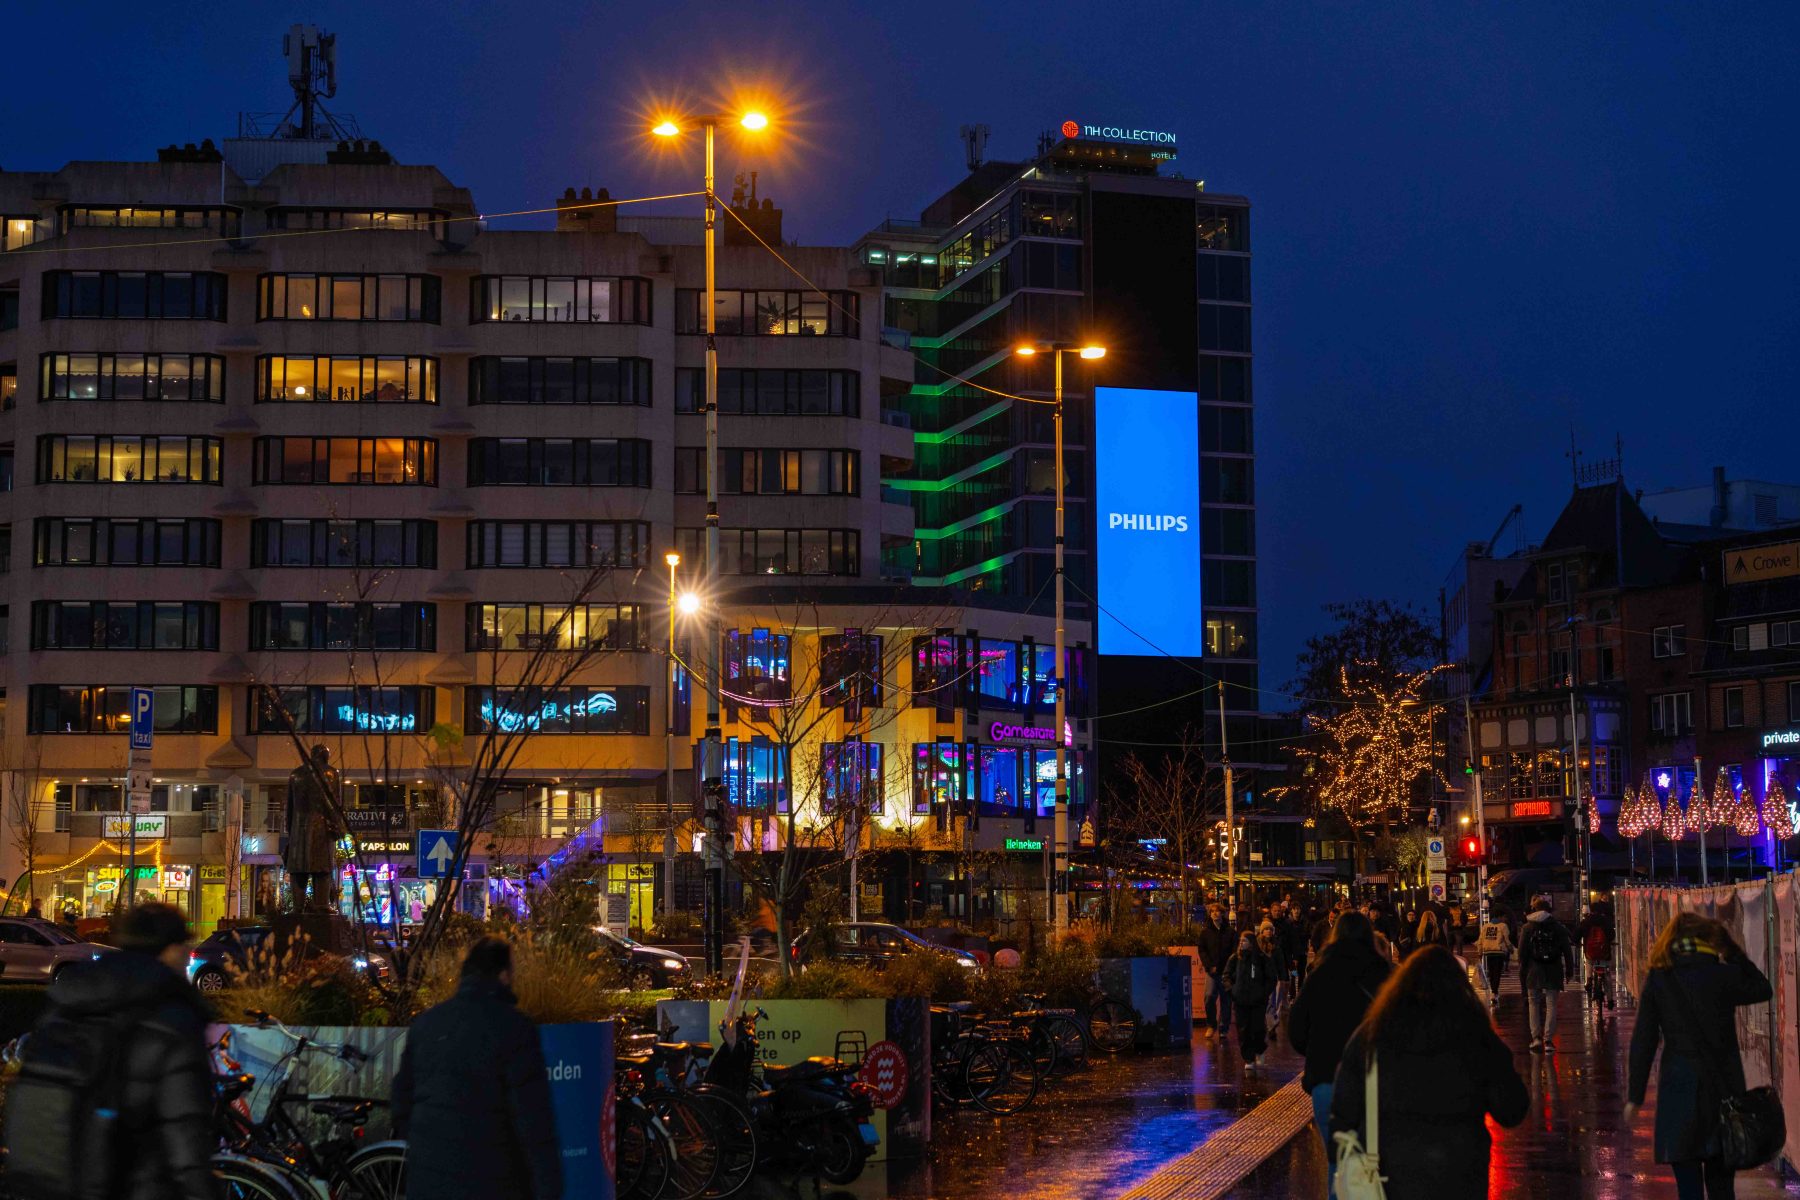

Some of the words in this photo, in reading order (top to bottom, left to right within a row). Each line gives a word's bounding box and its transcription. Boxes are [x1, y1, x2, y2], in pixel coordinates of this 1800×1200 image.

[1103, 127, 1176, 143] COLLECTION
[1151, 152, 1176, 160] HOTELS
[1109, 512, 1188, 532] PHILIPS
[1753, 555, 1791, 571] Crowe
[137, 693, 150, 723] P
[135, 731, 152, 743] taxi
[1764, 731, 1800, 747] private
[361, 842, 410, 851] KAPSLON
[1006, 838, 1041, 850] Heineken
[782, 1030, 801, 1043] op
